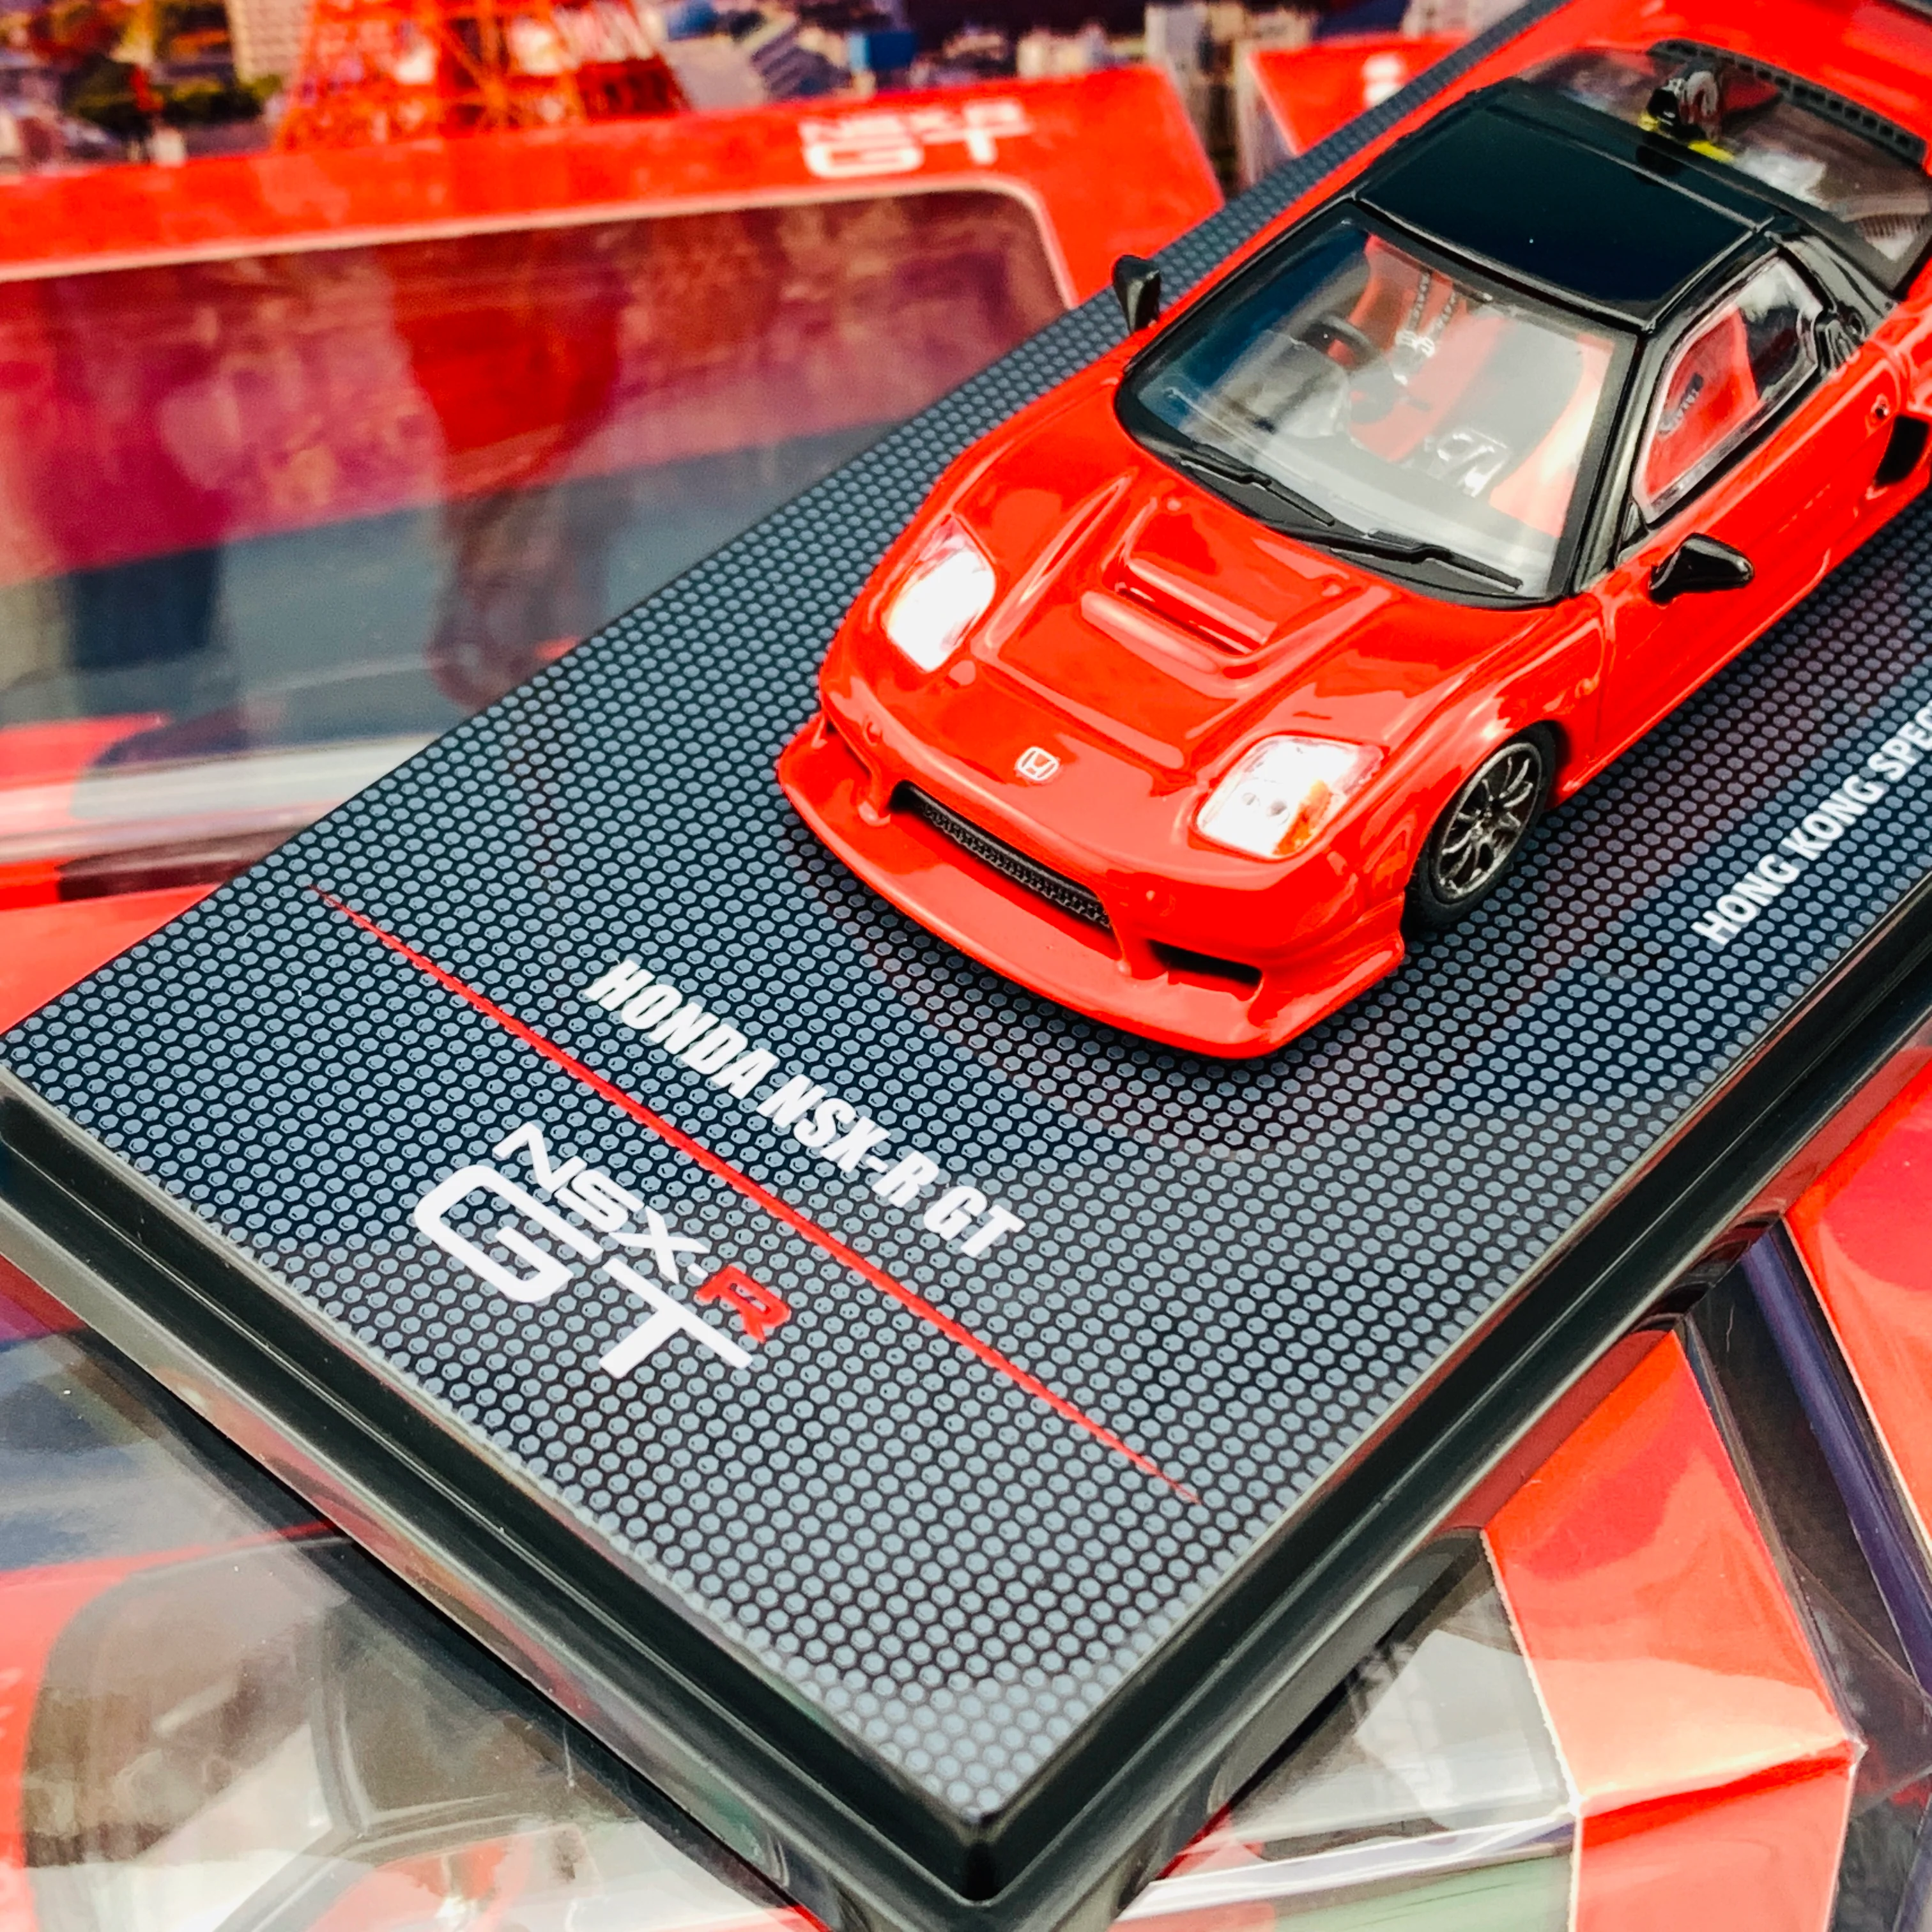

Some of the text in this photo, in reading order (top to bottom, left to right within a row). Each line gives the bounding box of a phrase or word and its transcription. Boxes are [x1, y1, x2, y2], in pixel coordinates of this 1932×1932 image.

[1690, 853, 1799, 947] HONG
[1781, 774, 1889, 861] KONG
[585, 959, 1026, 1259] HONDA NSX-R GT
[413, 1164, 754, 1380] GT
[492, 1121, 792, 1343] NSX-R
